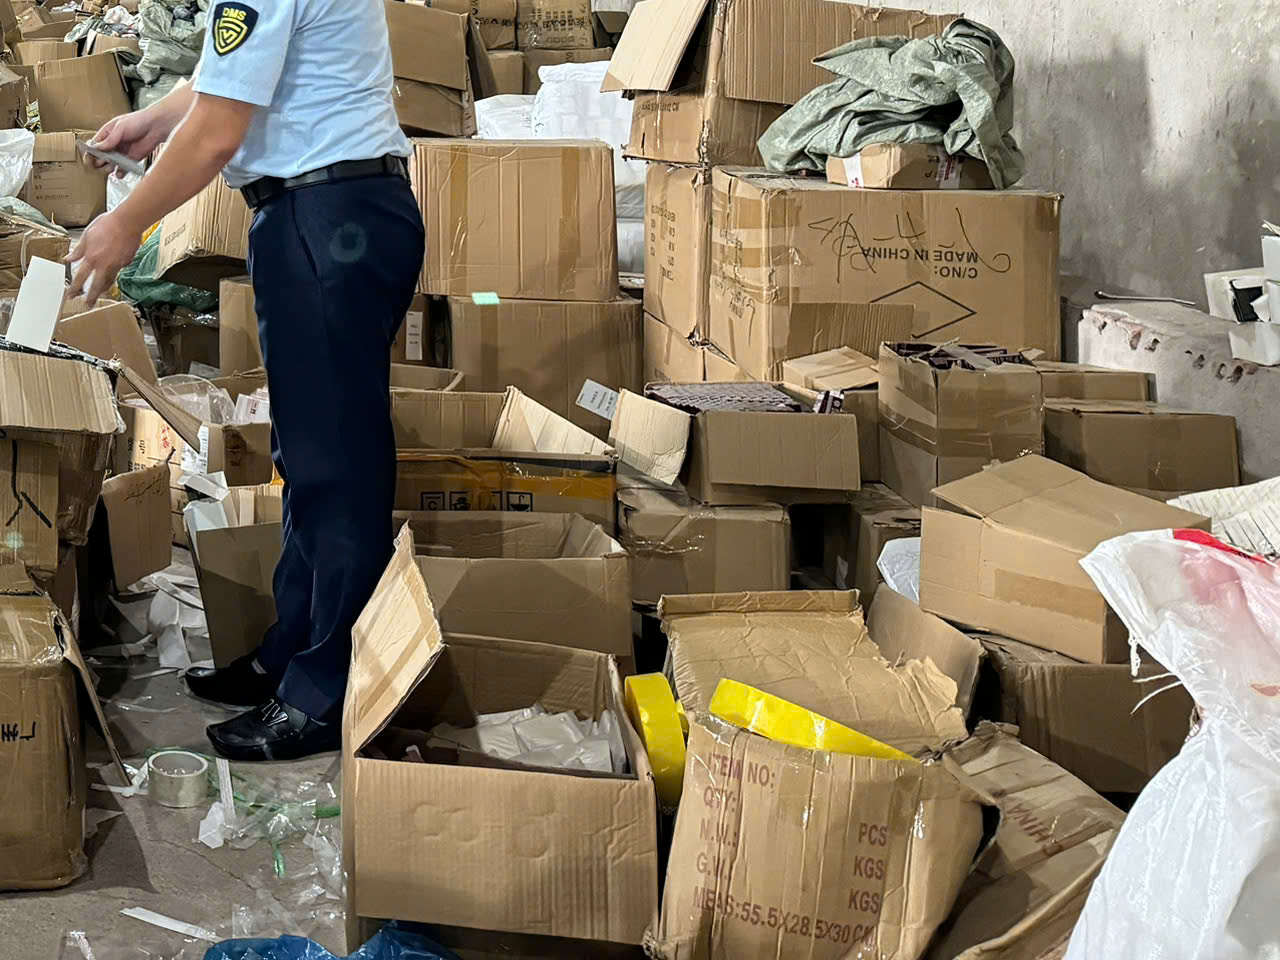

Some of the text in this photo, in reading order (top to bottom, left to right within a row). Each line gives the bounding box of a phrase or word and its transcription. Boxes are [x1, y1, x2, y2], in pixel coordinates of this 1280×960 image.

[222, 7, 247, 21] DMS
[862, 248, 978, 263] MADE IN CHINA
[933, 265, 978, 279] C/NO:
[707, 754, 776, 794] ITEM NO:
[703, 786, 737, 813] QTY:
[858, 822, 888, 847] PCS
[853, 855, 884, 881] KGS
[848, 891, 881, 915] KGS
